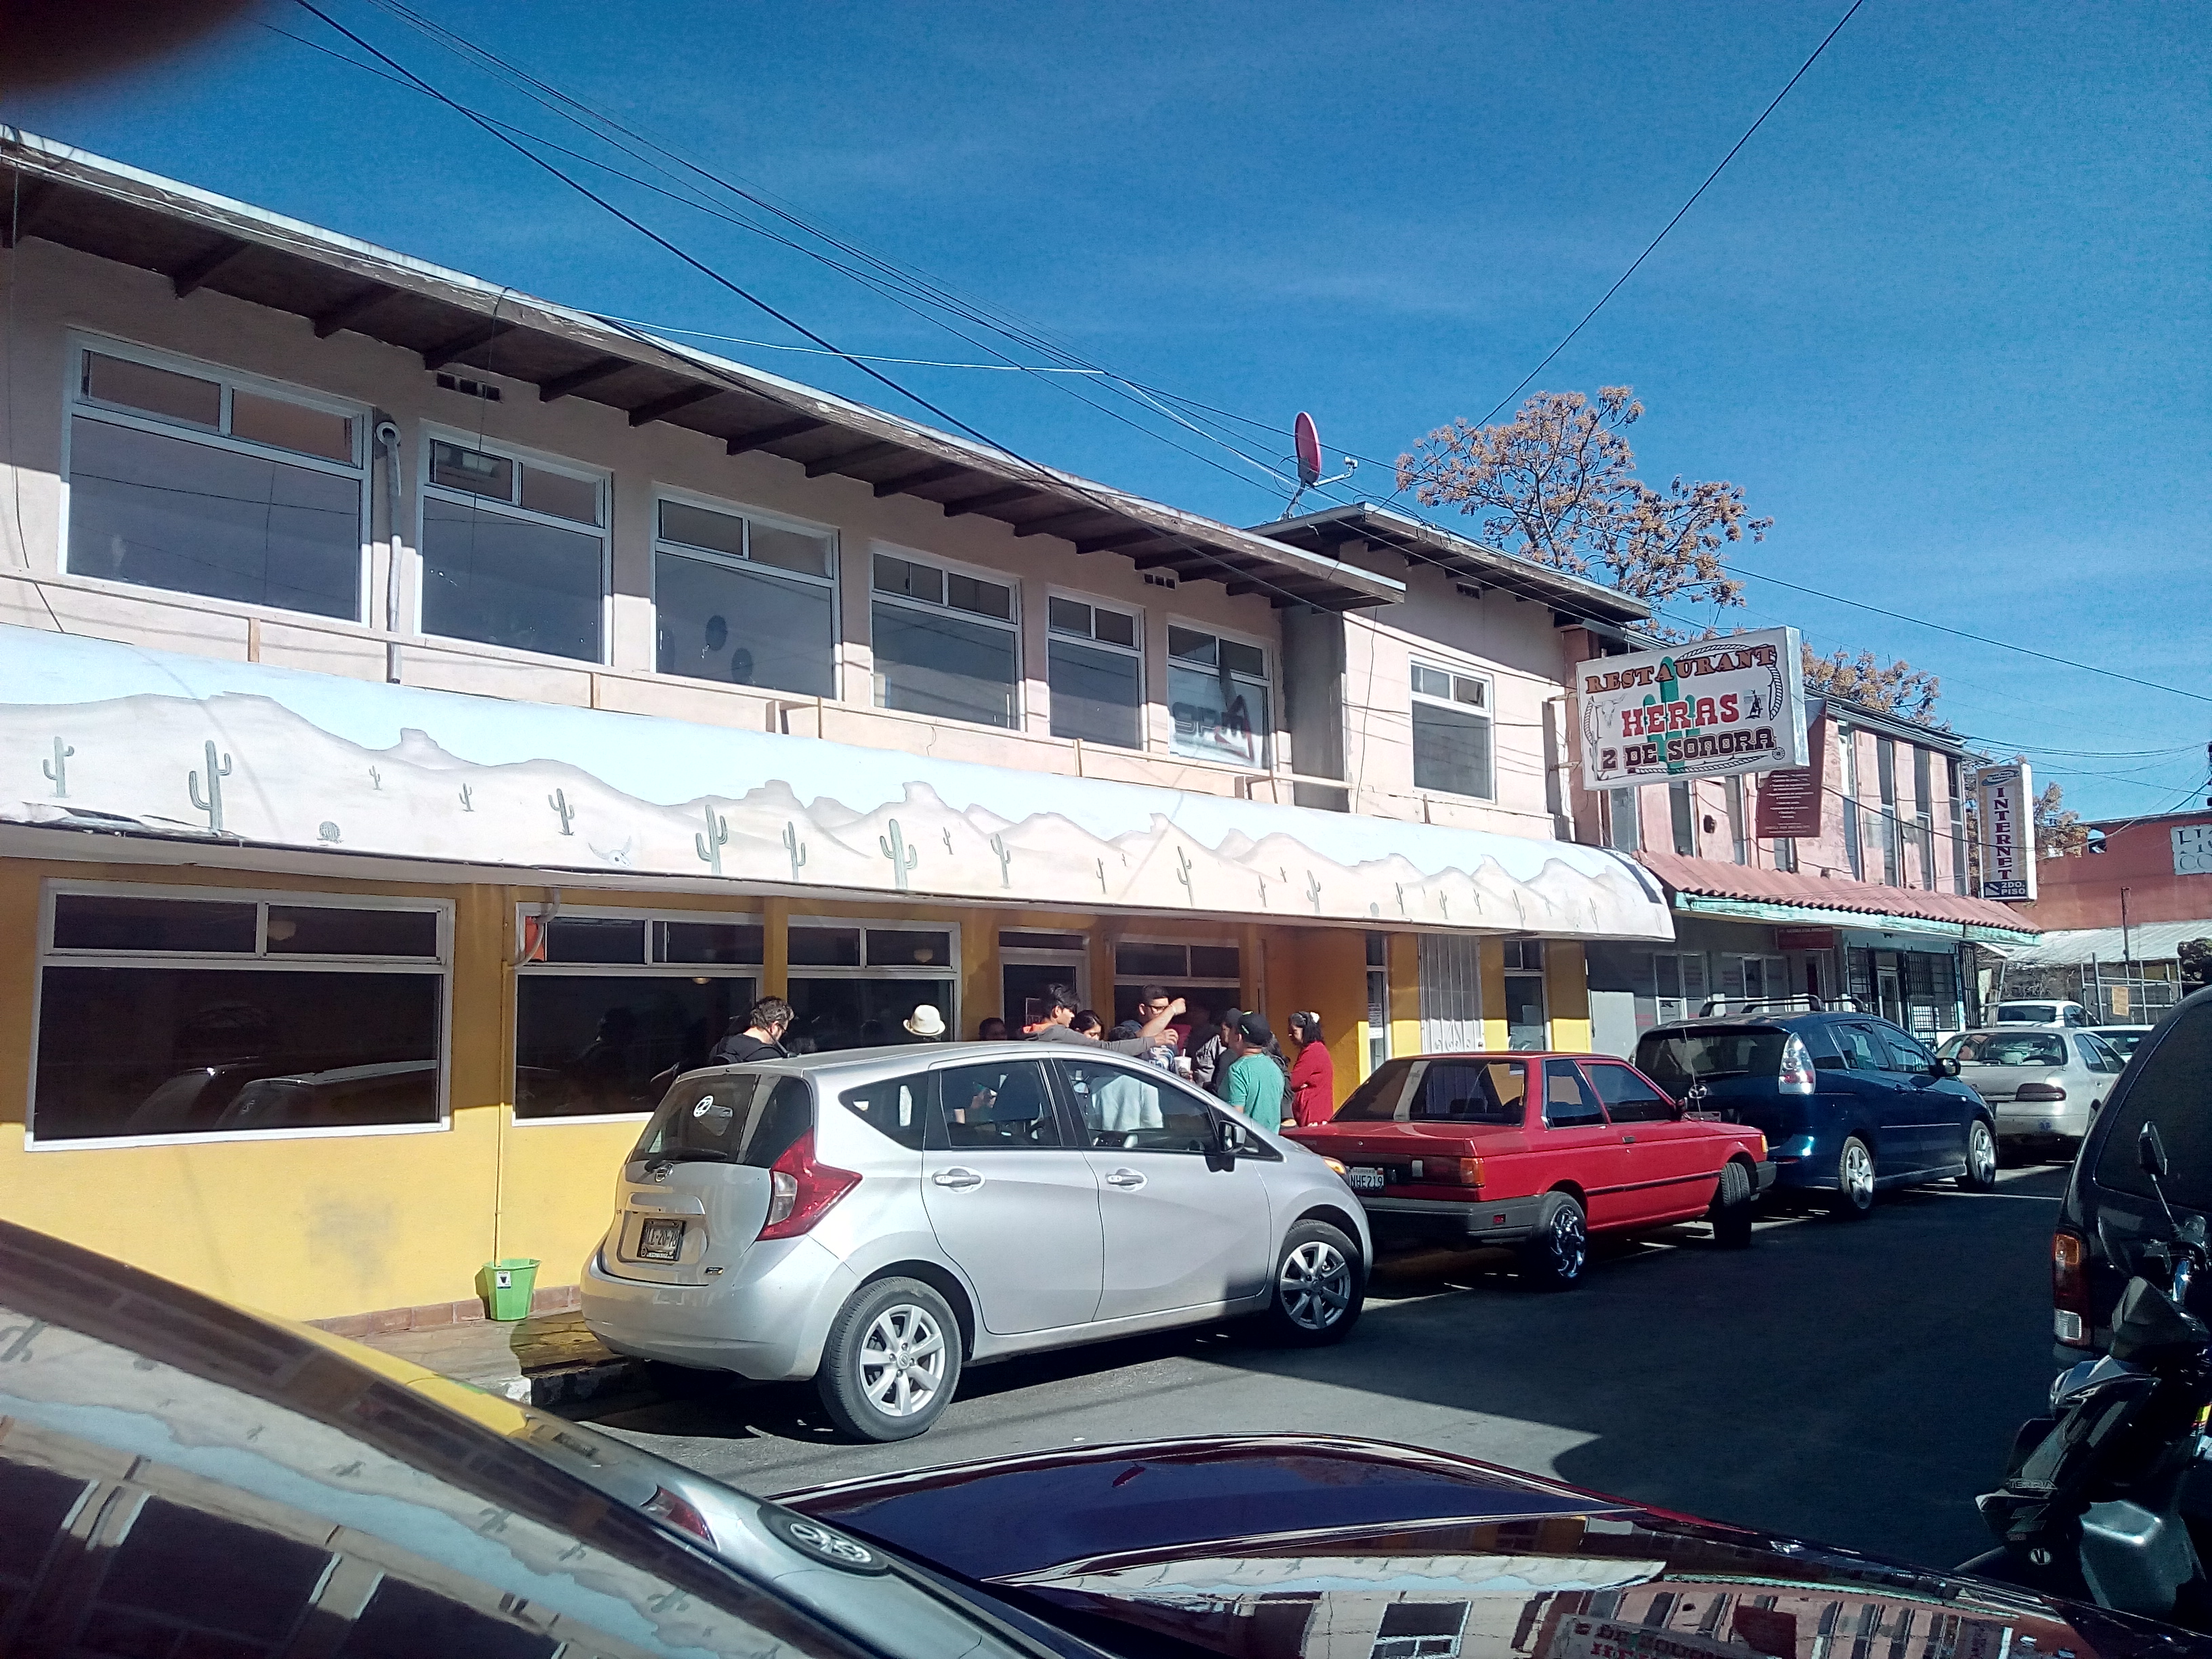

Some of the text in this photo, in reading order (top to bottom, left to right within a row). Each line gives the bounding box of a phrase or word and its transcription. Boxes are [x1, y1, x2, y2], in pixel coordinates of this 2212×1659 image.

[1586, 644, 1776, 694] RESTAURANT
[1621, 693, 1740, 738] HERAS
[1601, 726, 1777, 771] 2 DE SONORA
[1993, 787, 2013, 880] INTERNET
